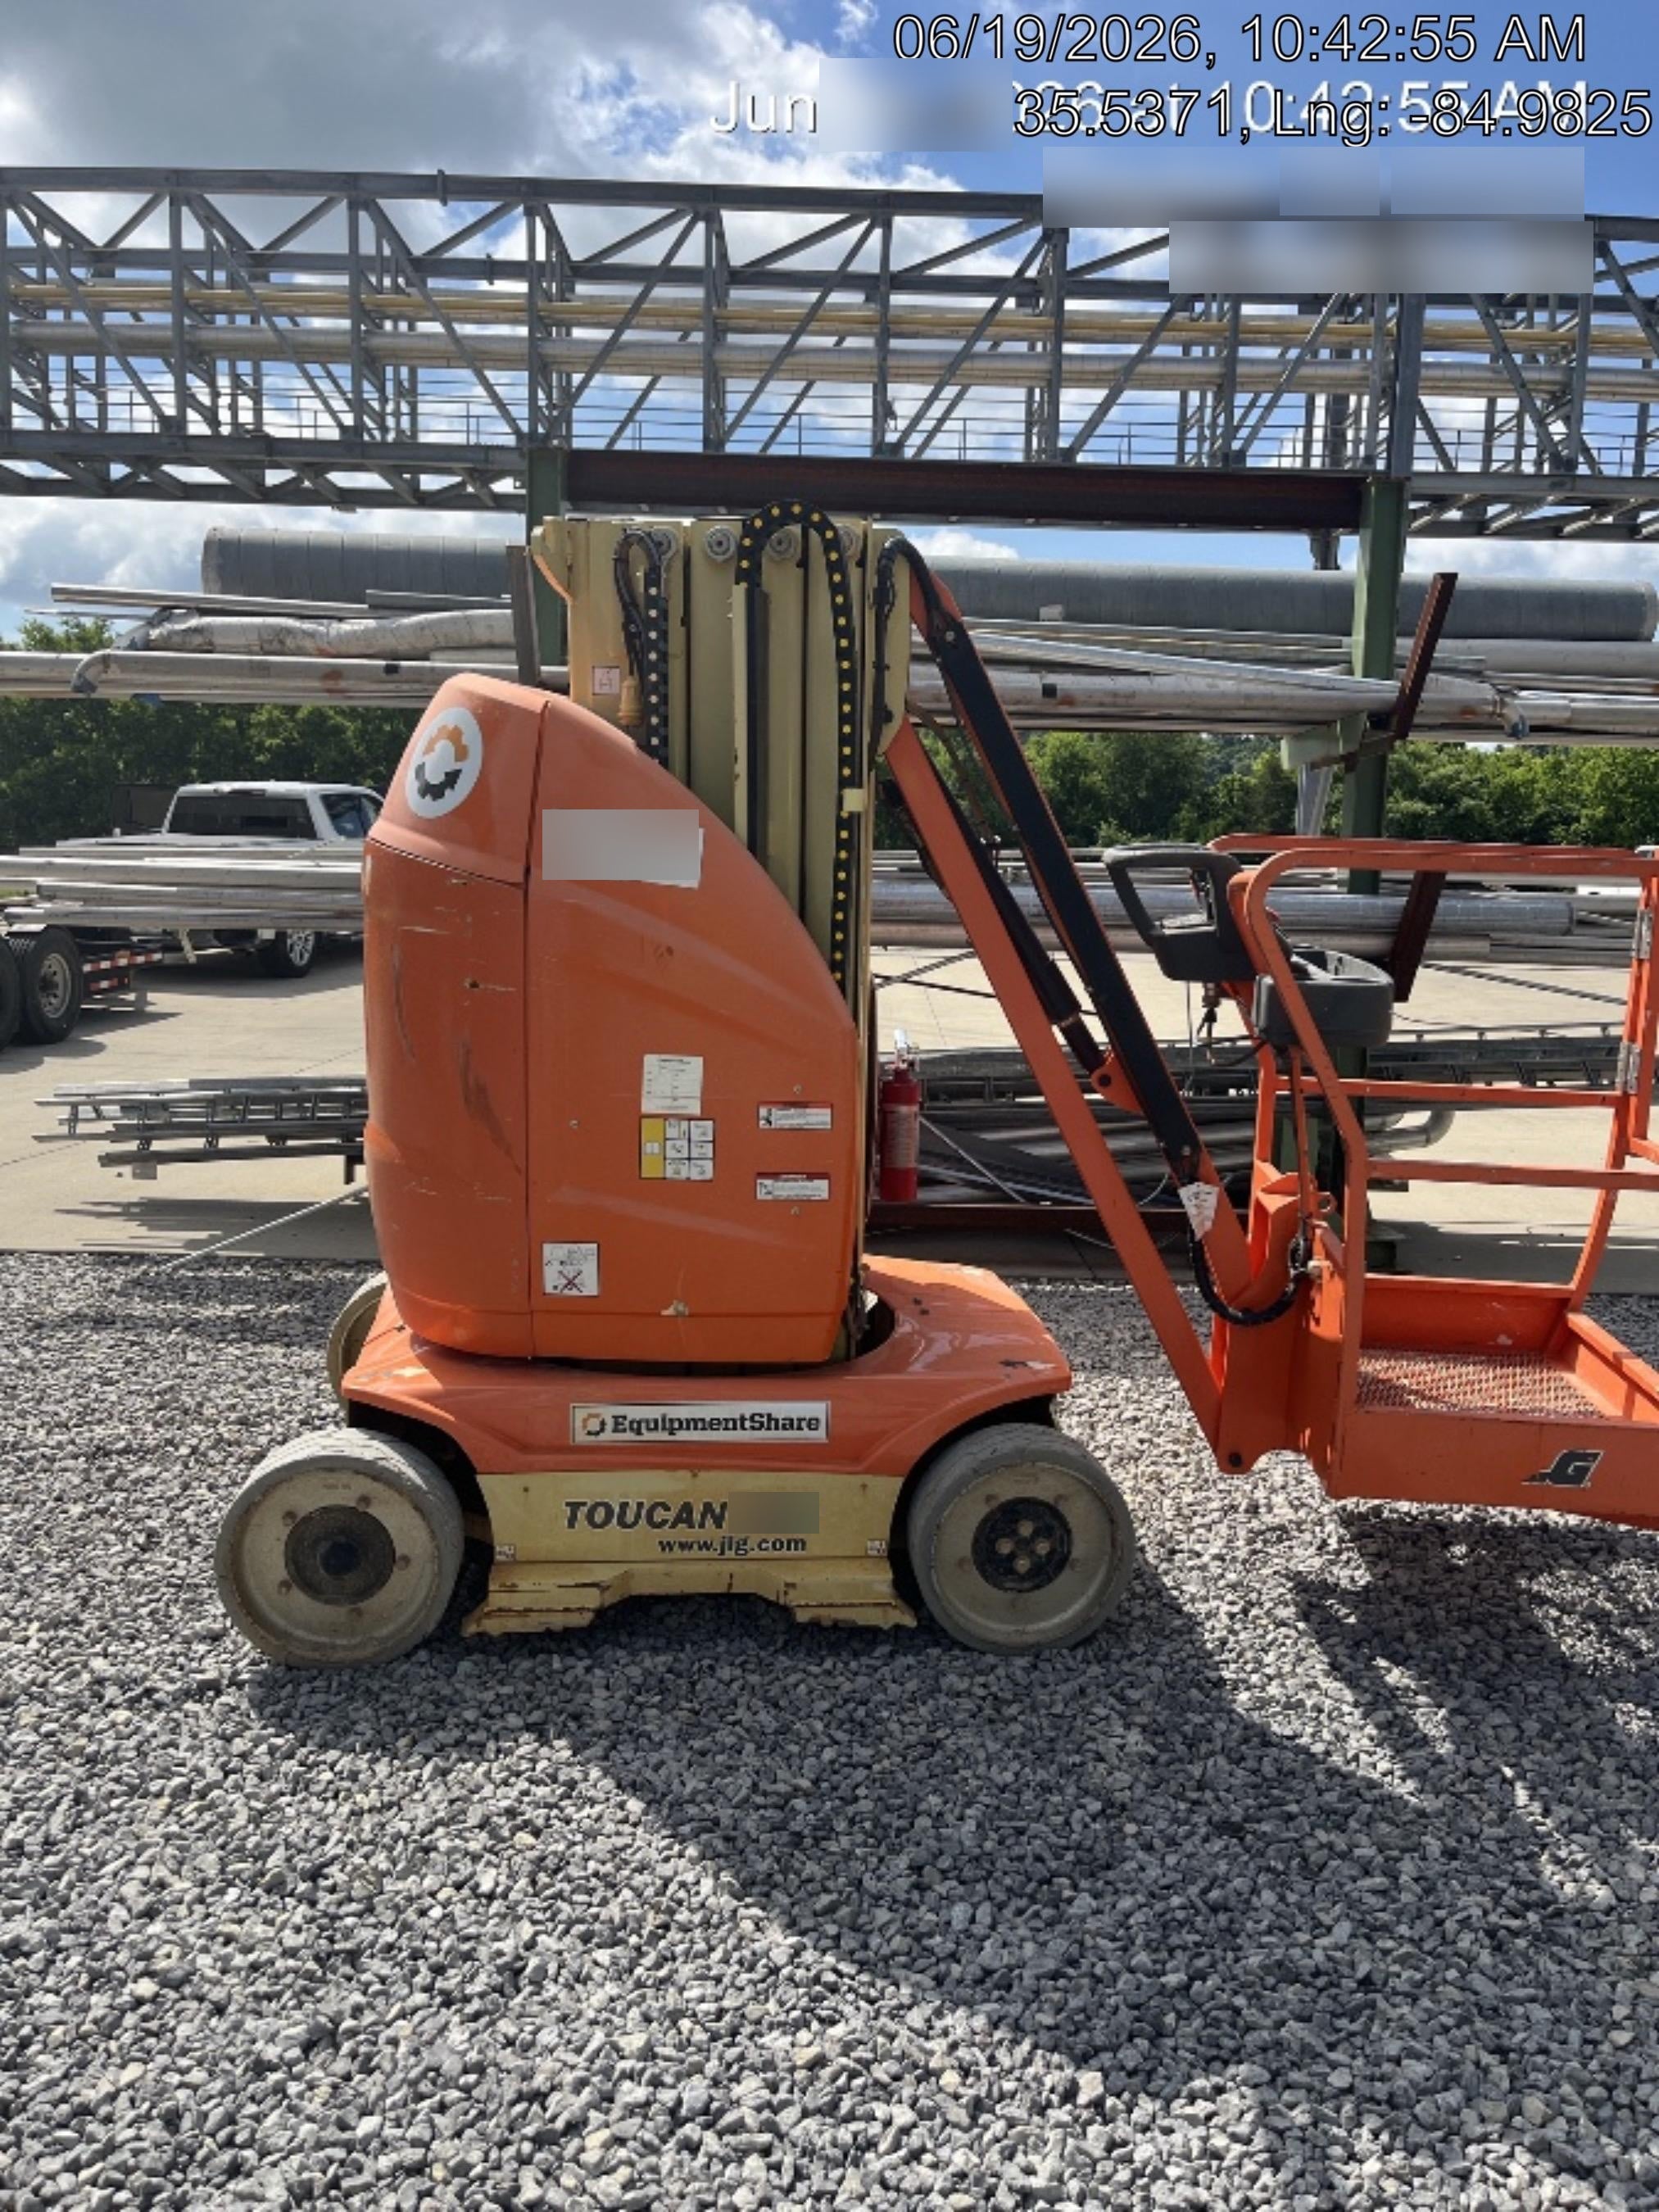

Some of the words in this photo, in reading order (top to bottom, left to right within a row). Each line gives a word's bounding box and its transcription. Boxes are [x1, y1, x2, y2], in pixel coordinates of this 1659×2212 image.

[612, 1412, 821, 1436] EquipmentShare
[564, 1499, 728, 1530] TOUCAN
[658, 1536, 807, 1557] www.jlg.com
